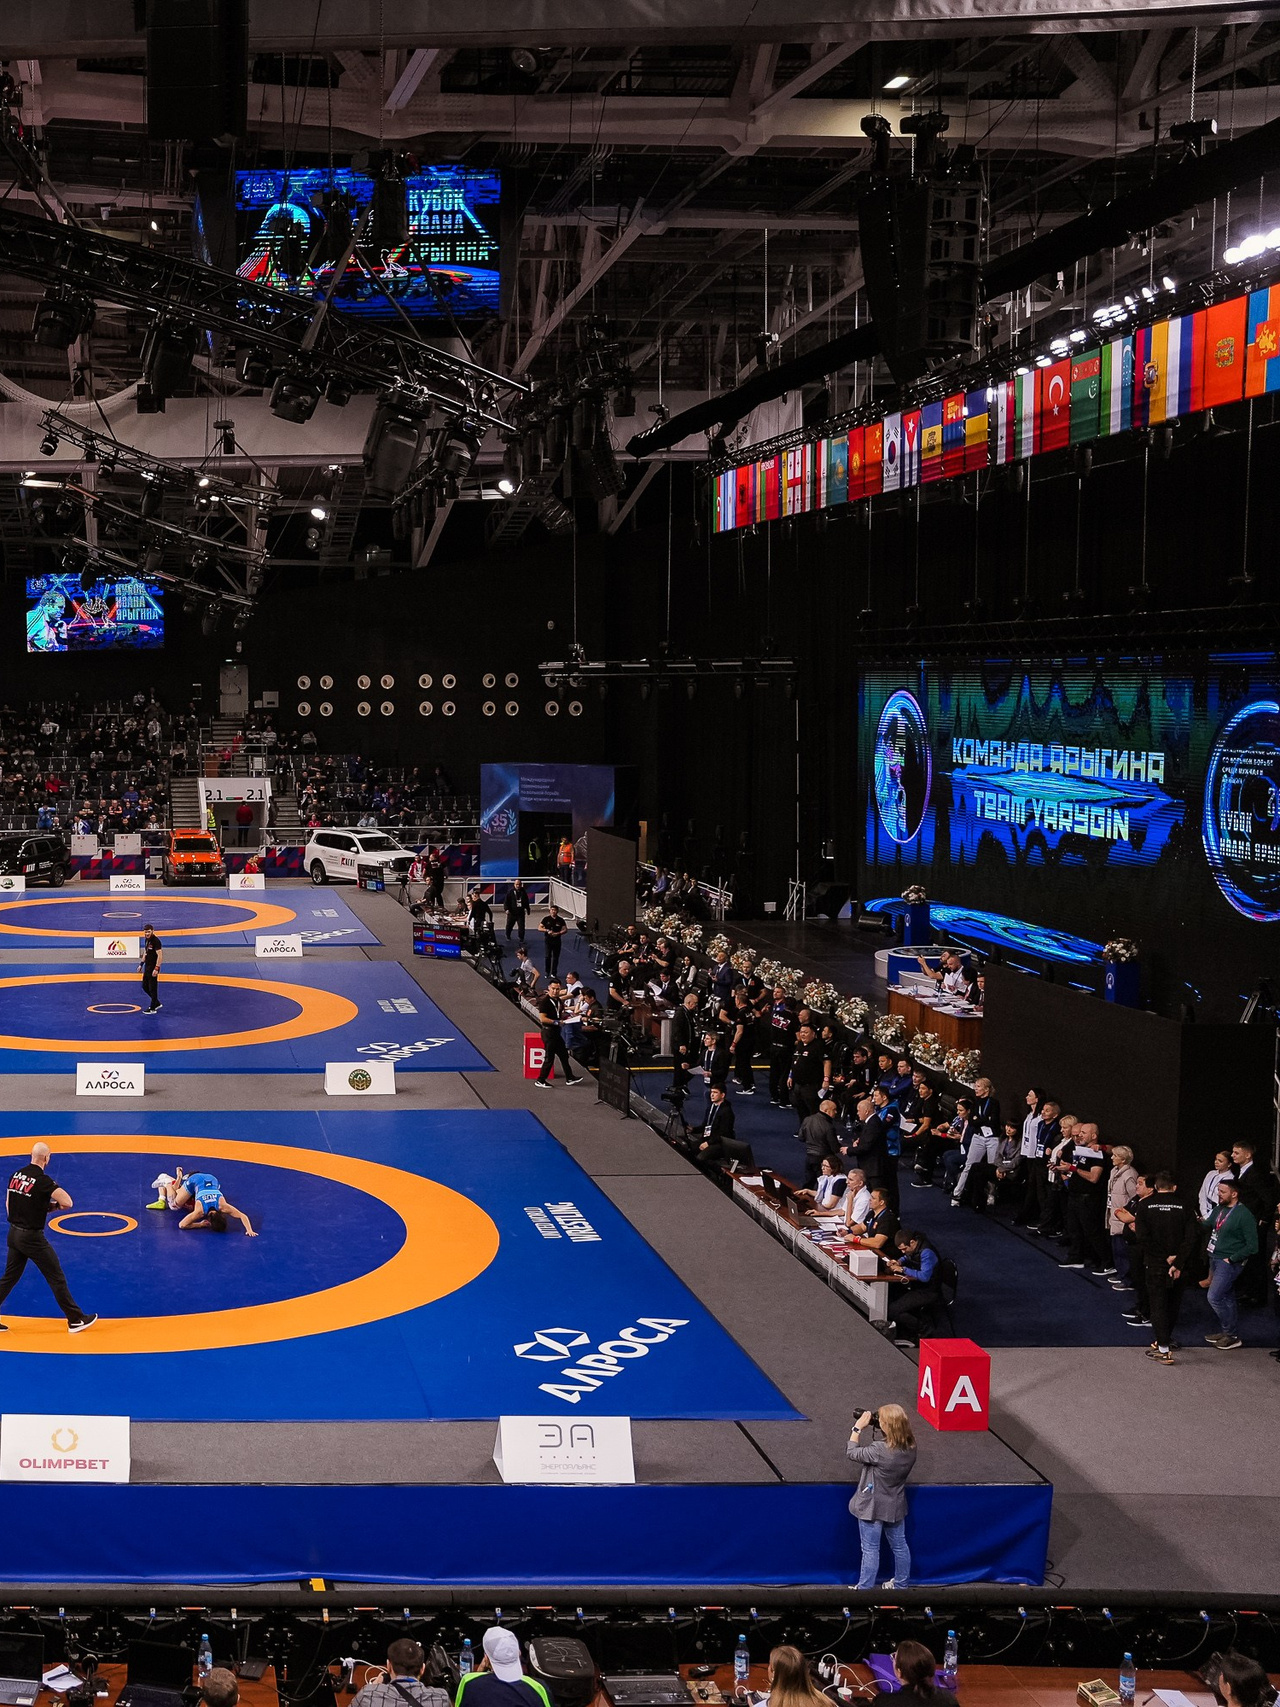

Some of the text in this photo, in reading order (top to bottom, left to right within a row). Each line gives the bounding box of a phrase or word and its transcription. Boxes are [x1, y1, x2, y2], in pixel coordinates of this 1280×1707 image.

[952, 737, 1165, 784] КОМАНДА ЯРЫГИНА
[205, 789, 265, 801] 2.1 2.1
[974, 790, 1026, 825] TEAM
[491, 813, 508, 826] 35
[85, 1081, 135, 1090] АЛРОСА
[544, 1201, 603, 1243] WRESTLING
[538, 1317, 690, 1404] АЛРОСА
[920, 1365, 936, 1409] A
[945, 1375, 983, 1412] A
[19, 1458, 110, 1470] OLIMPBET
